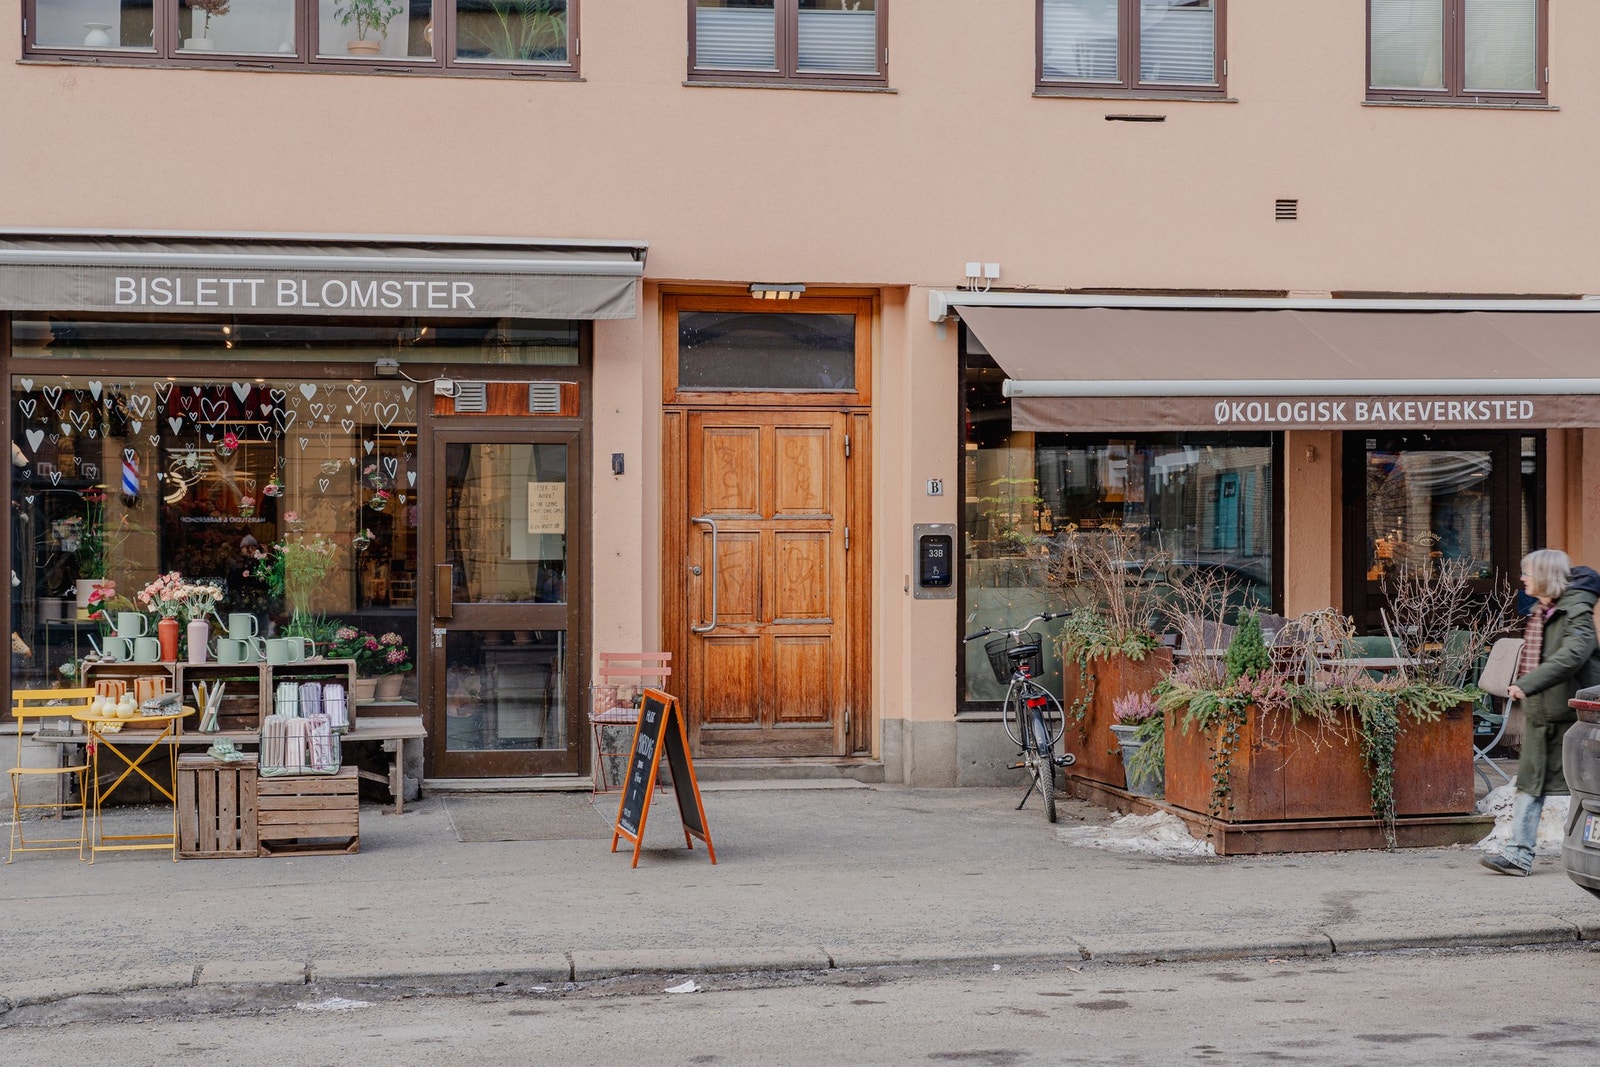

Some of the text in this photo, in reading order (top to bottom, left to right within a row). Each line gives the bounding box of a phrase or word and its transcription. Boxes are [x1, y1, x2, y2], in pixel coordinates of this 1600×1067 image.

[115, 276, 476, 309] BISLETT BLOMSTER
[1214, 399, 1534, 425] ØKOLOGISK BAKEVERKSTED
[931, 481, 939, 494] B
[928, 549, 944, 558] 33B
